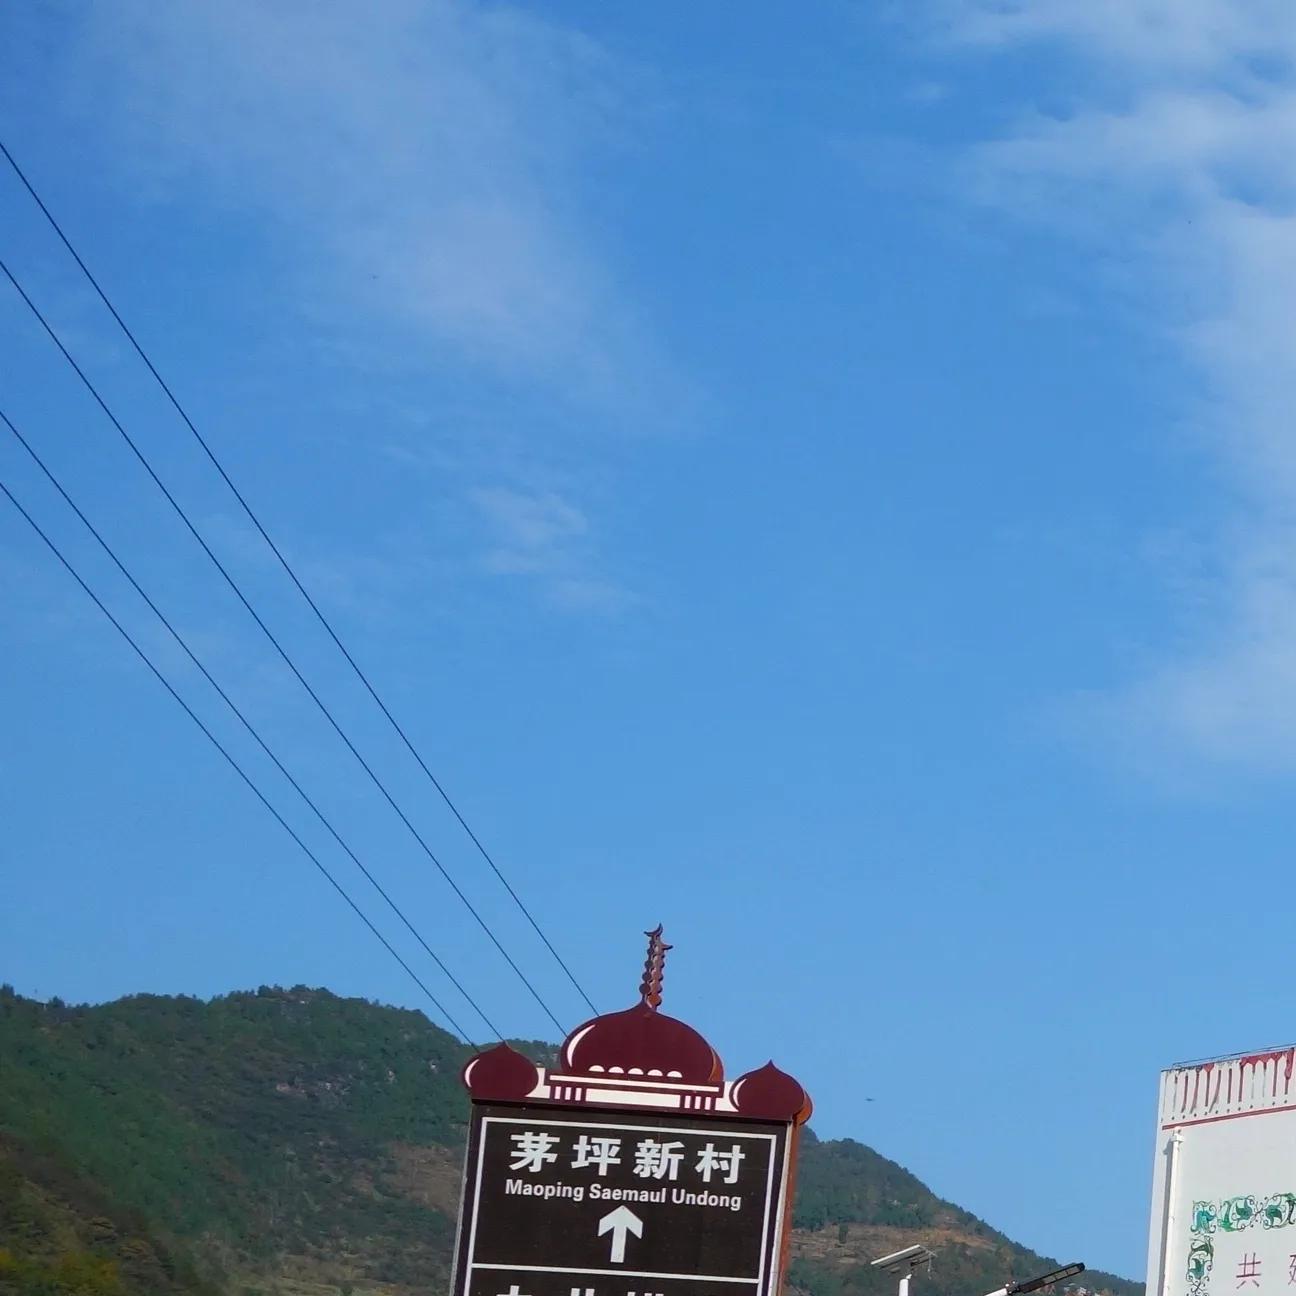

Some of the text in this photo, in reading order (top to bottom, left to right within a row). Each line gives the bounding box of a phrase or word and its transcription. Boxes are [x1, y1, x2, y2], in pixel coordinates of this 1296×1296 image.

[510, 1132, 745, 1184] 茅坪新村
[505, 1179, 741, 1211] Maoping Saemaul Undong
